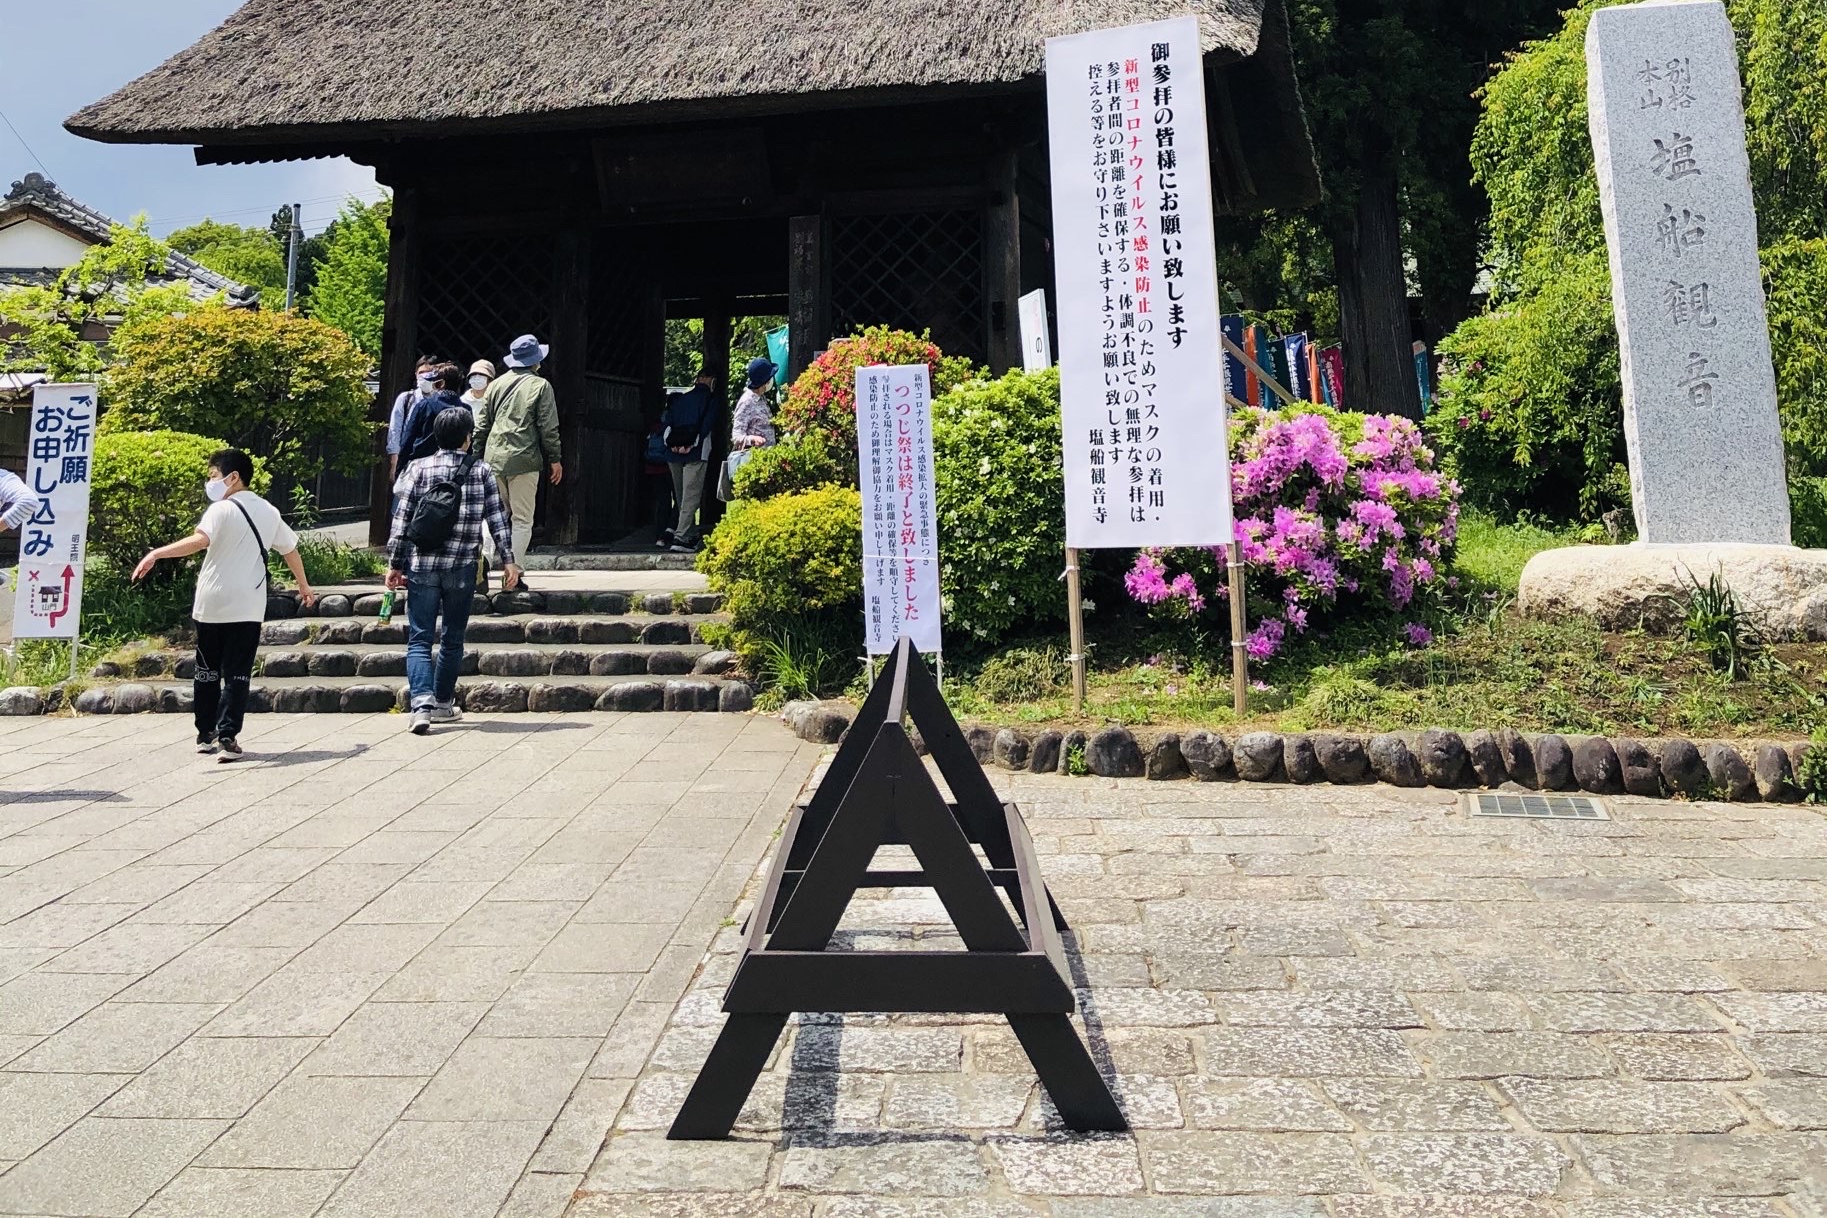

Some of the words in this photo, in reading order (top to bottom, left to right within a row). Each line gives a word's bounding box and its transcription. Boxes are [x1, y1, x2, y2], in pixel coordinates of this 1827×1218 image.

[1150, 42, 1188, 349] 御参拝の皆様にお願い致します
[1088, 64, 1123, 465] 控える等をお守り下さいますようお願い致します
[24, 405, 65, 557] お申し込み
[59, 395, 93, 483] ご祈願
[1089, 428, 1108, 524] 塩船観音寺
[895, 385, 919, 620] つつじ祭は終了と致しました
[42, 603, 57, 611] 山門
[871, 595, 882, 643] 塩船観音寺
